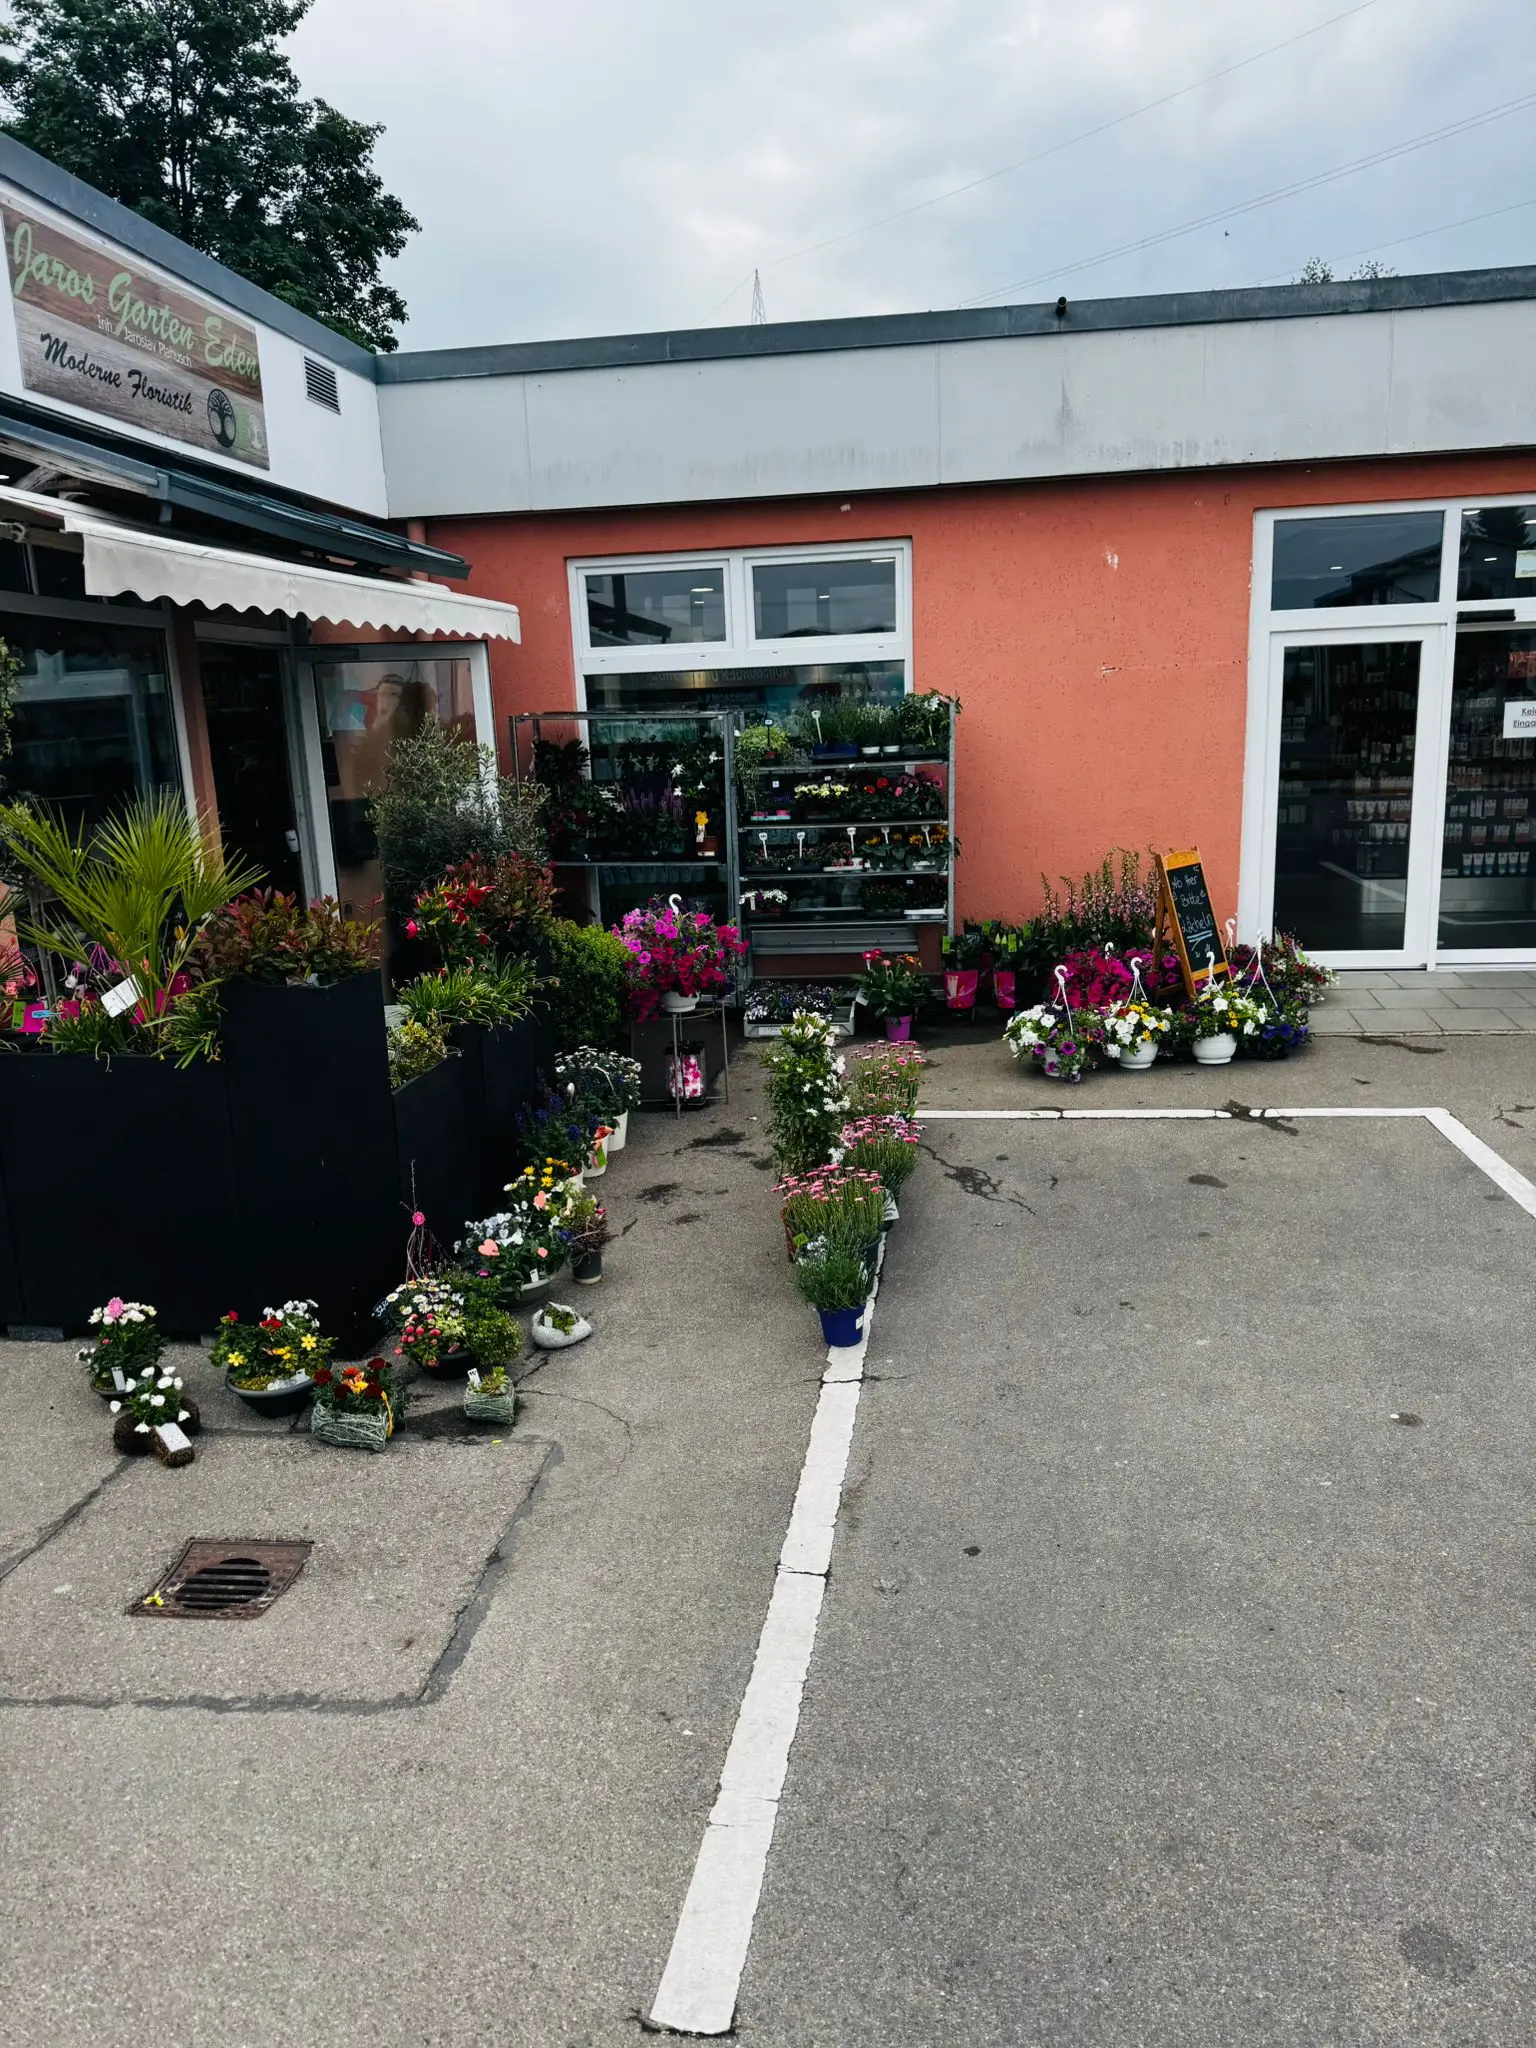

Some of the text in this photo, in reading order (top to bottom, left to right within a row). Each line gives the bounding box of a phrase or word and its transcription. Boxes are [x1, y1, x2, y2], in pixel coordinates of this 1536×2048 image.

[12, 222, 259, 379] Jaros Garten Eden
[40, 333, 194, 415] Moderne Floristik
[1180, 891, 1203, 907] Bitte
